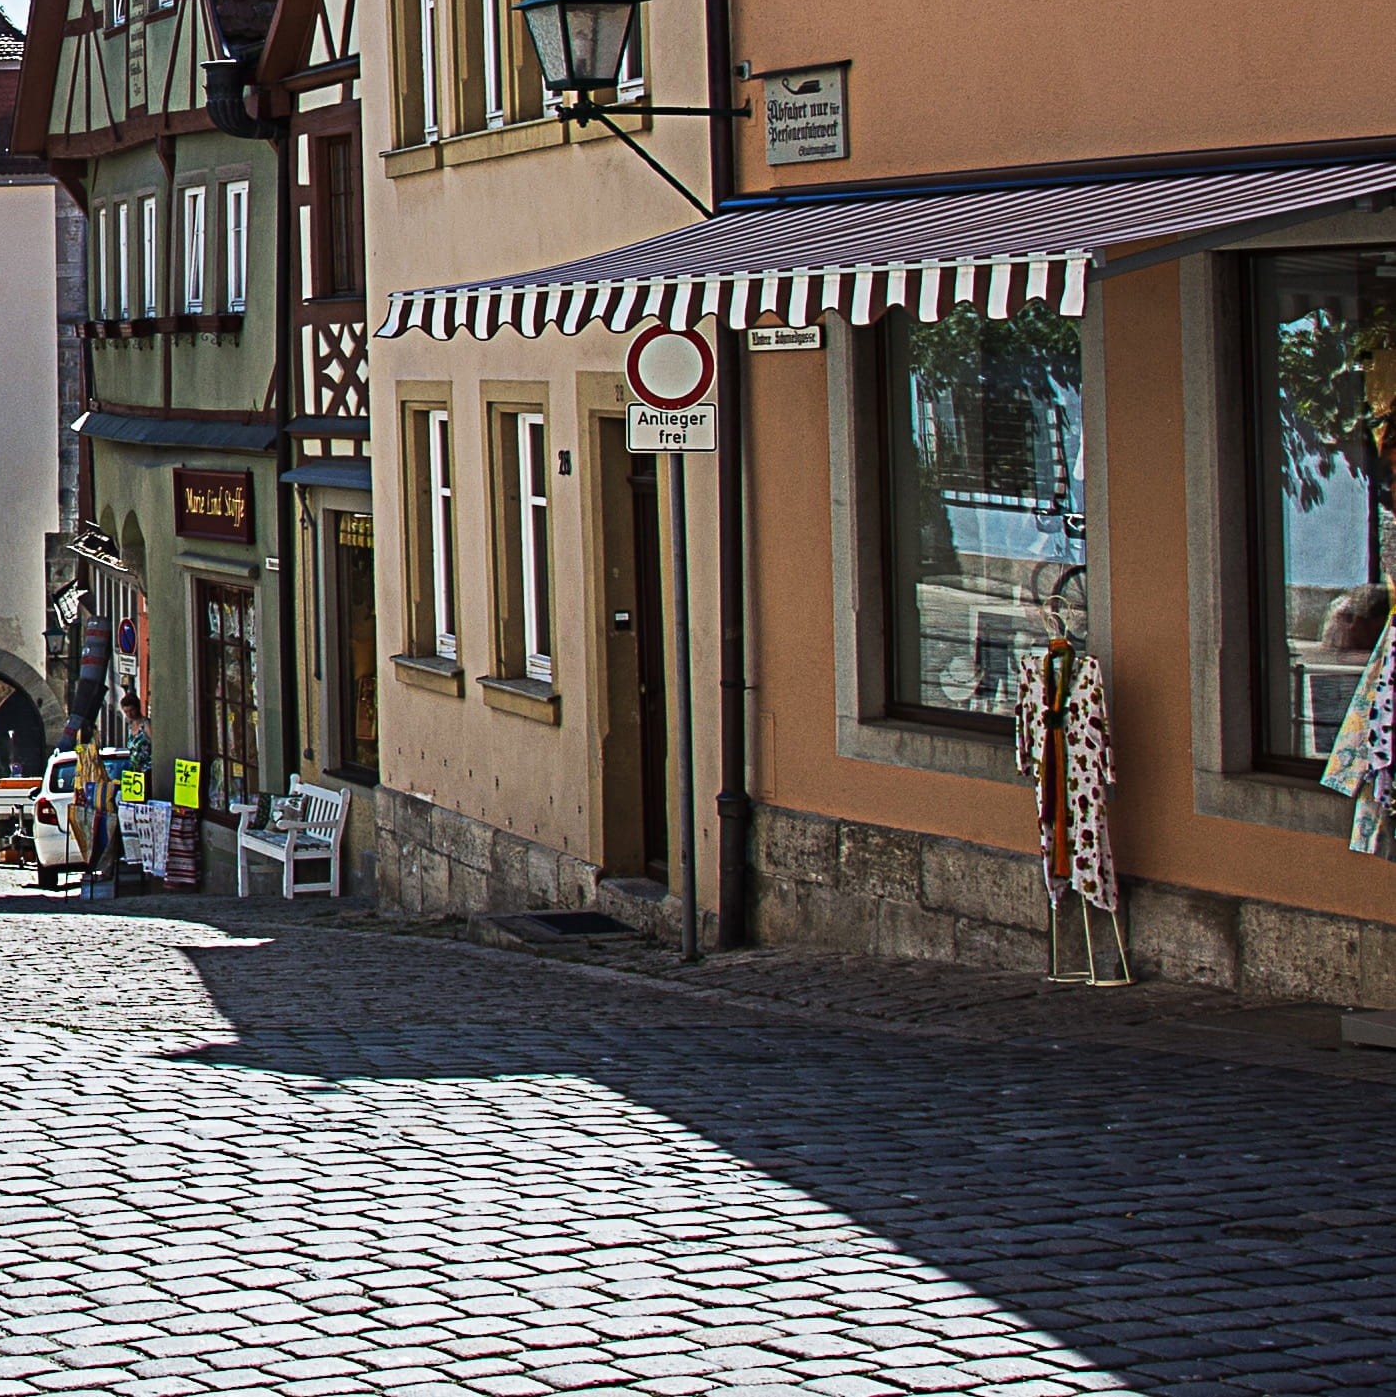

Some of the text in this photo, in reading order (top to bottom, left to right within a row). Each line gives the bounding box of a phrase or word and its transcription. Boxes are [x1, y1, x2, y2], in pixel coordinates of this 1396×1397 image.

[810, 102, 829, 118] nur
[637, 410, 707, 430] Anlieger
[659, 429, 687, 445] frei
